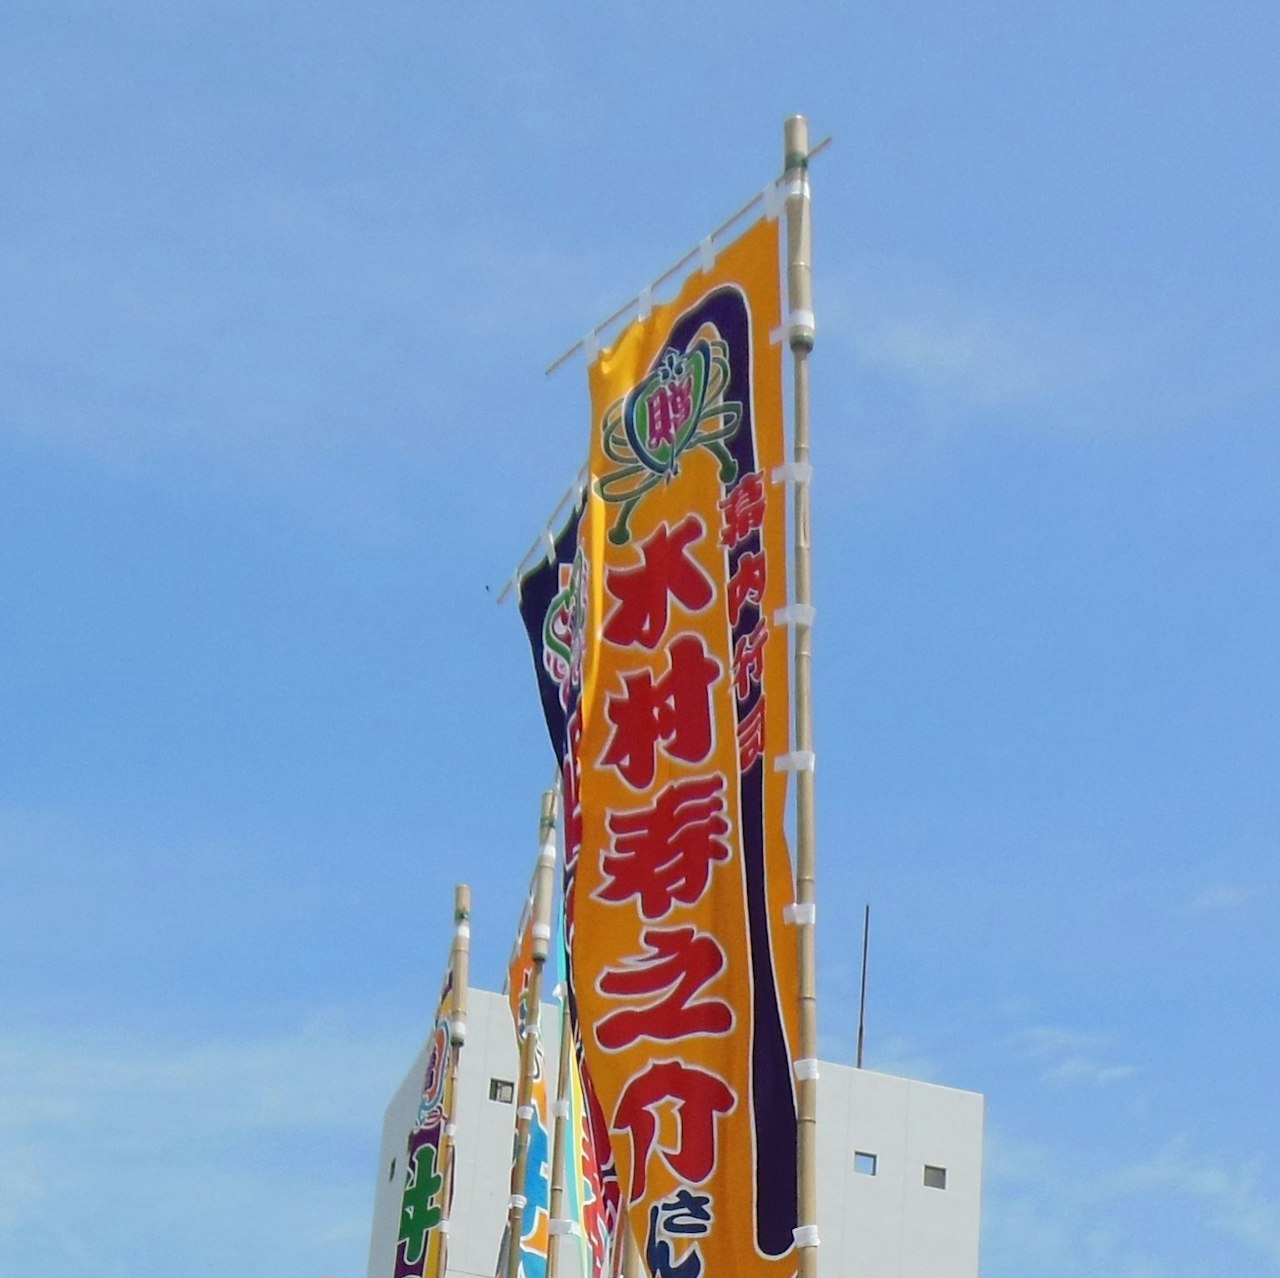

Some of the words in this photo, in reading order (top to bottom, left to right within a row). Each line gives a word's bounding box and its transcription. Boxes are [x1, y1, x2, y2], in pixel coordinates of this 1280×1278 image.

[590, 512, 737, 1206] 木村寿之介
